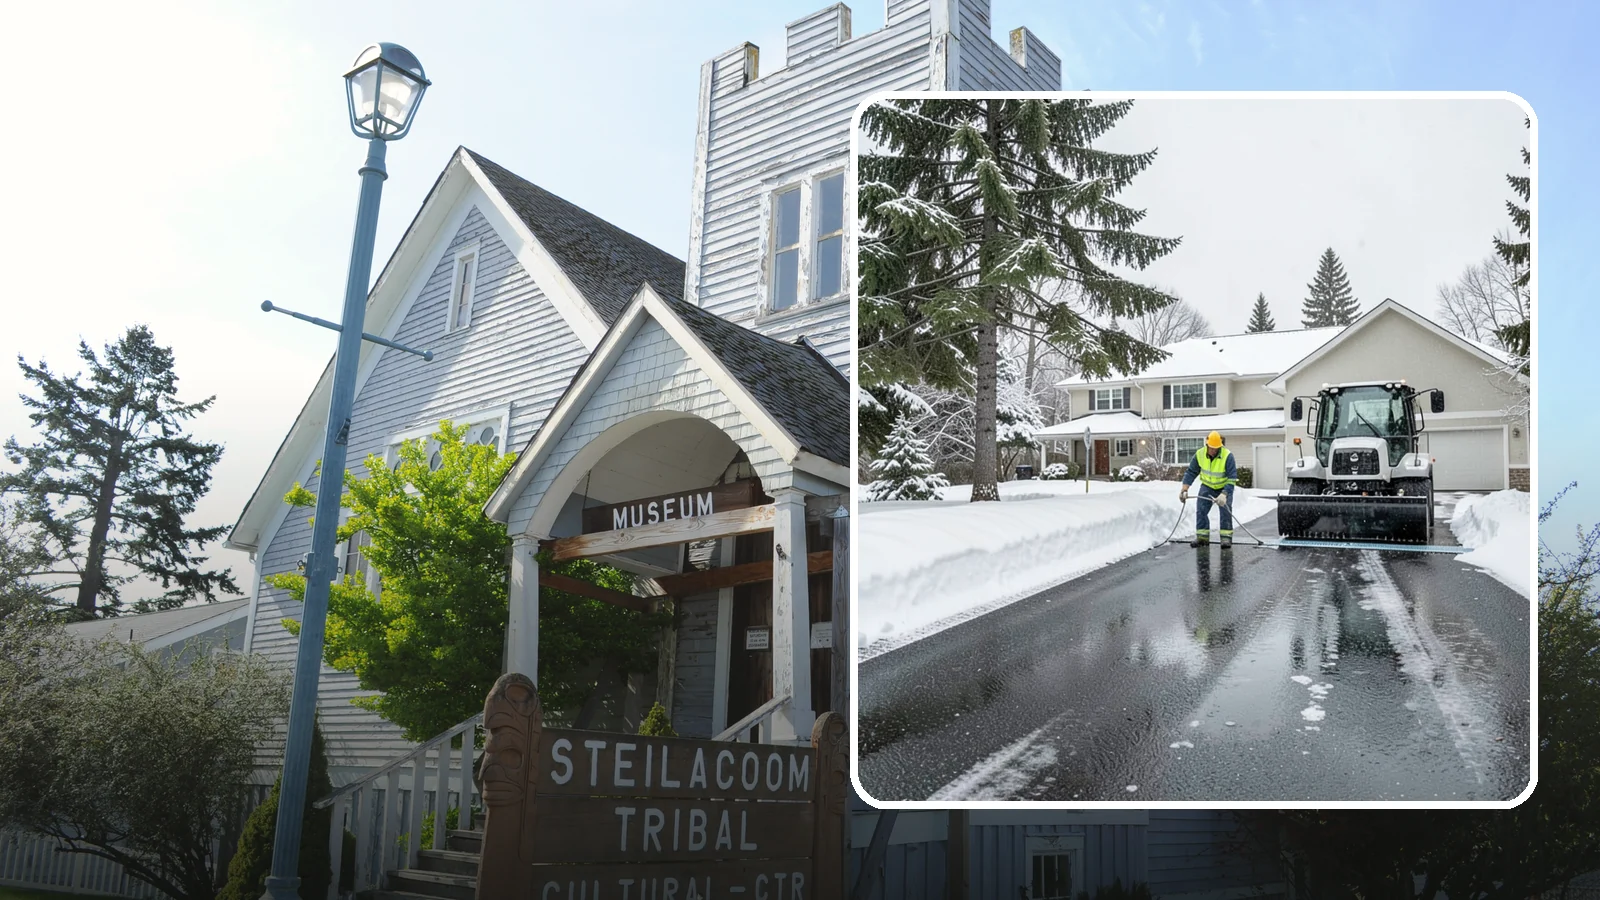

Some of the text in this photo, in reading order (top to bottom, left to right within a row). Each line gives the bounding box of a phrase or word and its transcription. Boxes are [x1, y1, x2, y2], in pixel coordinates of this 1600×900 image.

[613, 491, 714, 531] MUSEUM
[551, 738, 809, 793] STEILACOOM
[615, 806, 758, 852] TRIBAL
